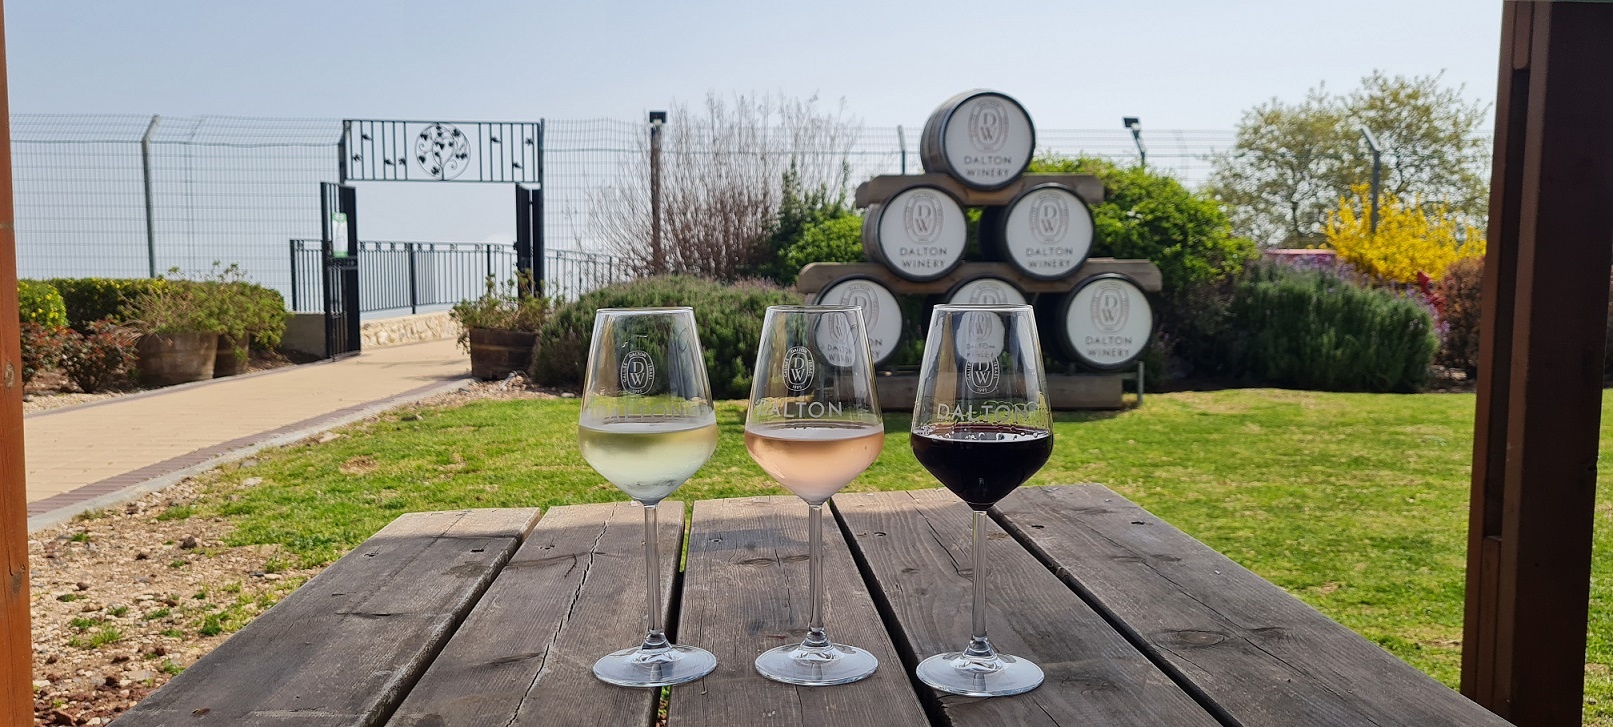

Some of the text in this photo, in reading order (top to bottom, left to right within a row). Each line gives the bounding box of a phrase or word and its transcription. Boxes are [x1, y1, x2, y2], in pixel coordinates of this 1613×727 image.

[963, 156, 1012, 165] DALTON
[966, 168, 1009, 177] WINERY
[899, 247, 947, 256] DALTON
[1026, 247, 1073, 257] DALTON
[902, 260, 945, 268] WINERY
[1029, 260, 1070, 268] WINERY
[1085, 336, 1133, 345] DALTON
[1088, 349, 1129, 357] WINERY
[936, 403, 1028, 422] DALTON
